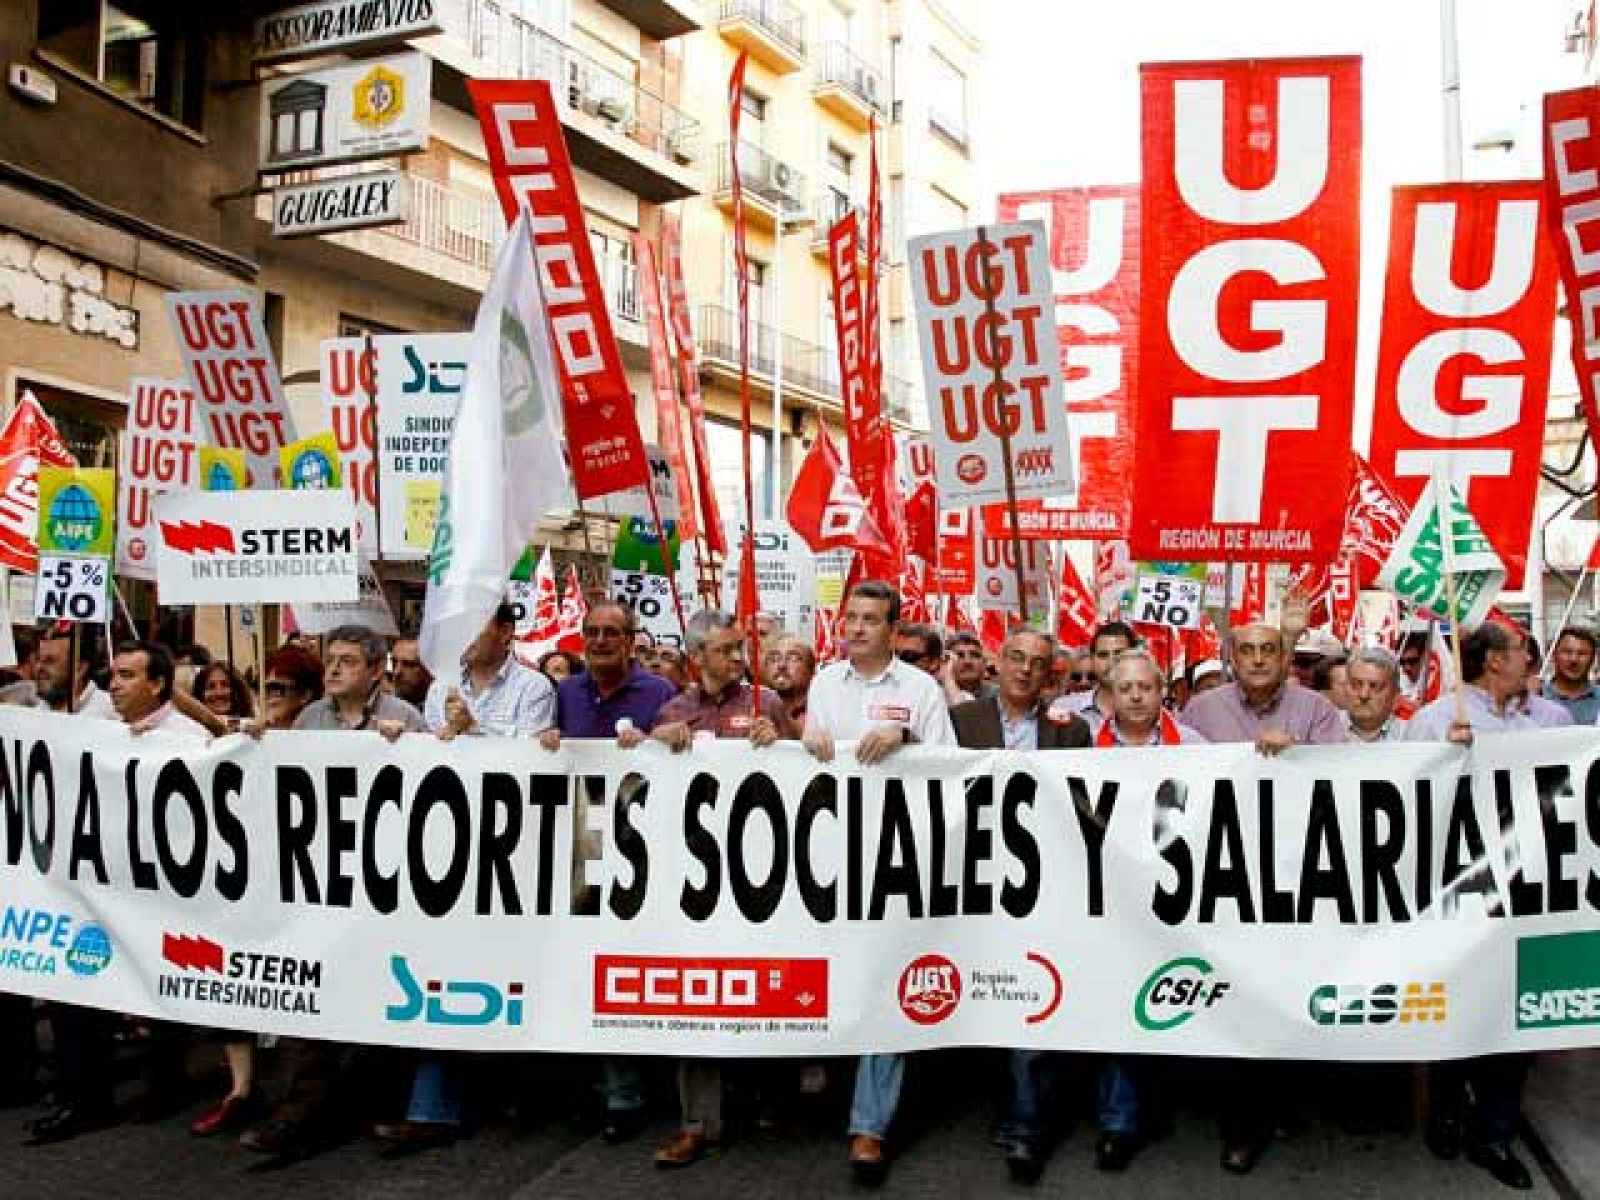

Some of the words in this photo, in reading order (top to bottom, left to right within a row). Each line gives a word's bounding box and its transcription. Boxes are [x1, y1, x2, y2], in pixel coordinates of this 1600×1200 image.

[279, 180, 396, 226] GUIGALEX
[922, 234, 1034, 307] UGT
[1167, 75, 1331, 525] UGT
[175, 301, 256, 352] UGT
[931, 306, 1042, 376] UGT
[193, 357, 274, 406] UGT
[329, 349, 379, 397] UG
[135, 384, 195, 433] UGT
[333, 404, 379, 454] UG
[940, 374, 1051, 444] UGT
[131, 435, 195, 486] UGT
[394, 457, 414, 473] DE
[242, 527, 352, 555] STERM
[42, 562, 72, 589] -5
[81, 564, 103, 586] %
[191, 559, 352, 577] INTERSINDICAL
[612, 574, 643, 594] -5
[43, 590, 95, 618] NO
[1142, 581, 1170, 601] -5
[1143, 602, 1188, 627] NO
[0, 738, 55, 874] NO
[70, 751, 110, 885] A
[125, 757, 249, 901] LOS
[276, 763, 650, 921] RECORTES
[680, 770, 1041, 924] SOCIALES
[1066, 776, 1121, 918] Y
[1, 905, 72, 948] NPE
[228, 951, 321, 988] STERM
[604, 966, 758, 1006] CCOO
[159, 974, 321, 1015] INTERSINDICAL
